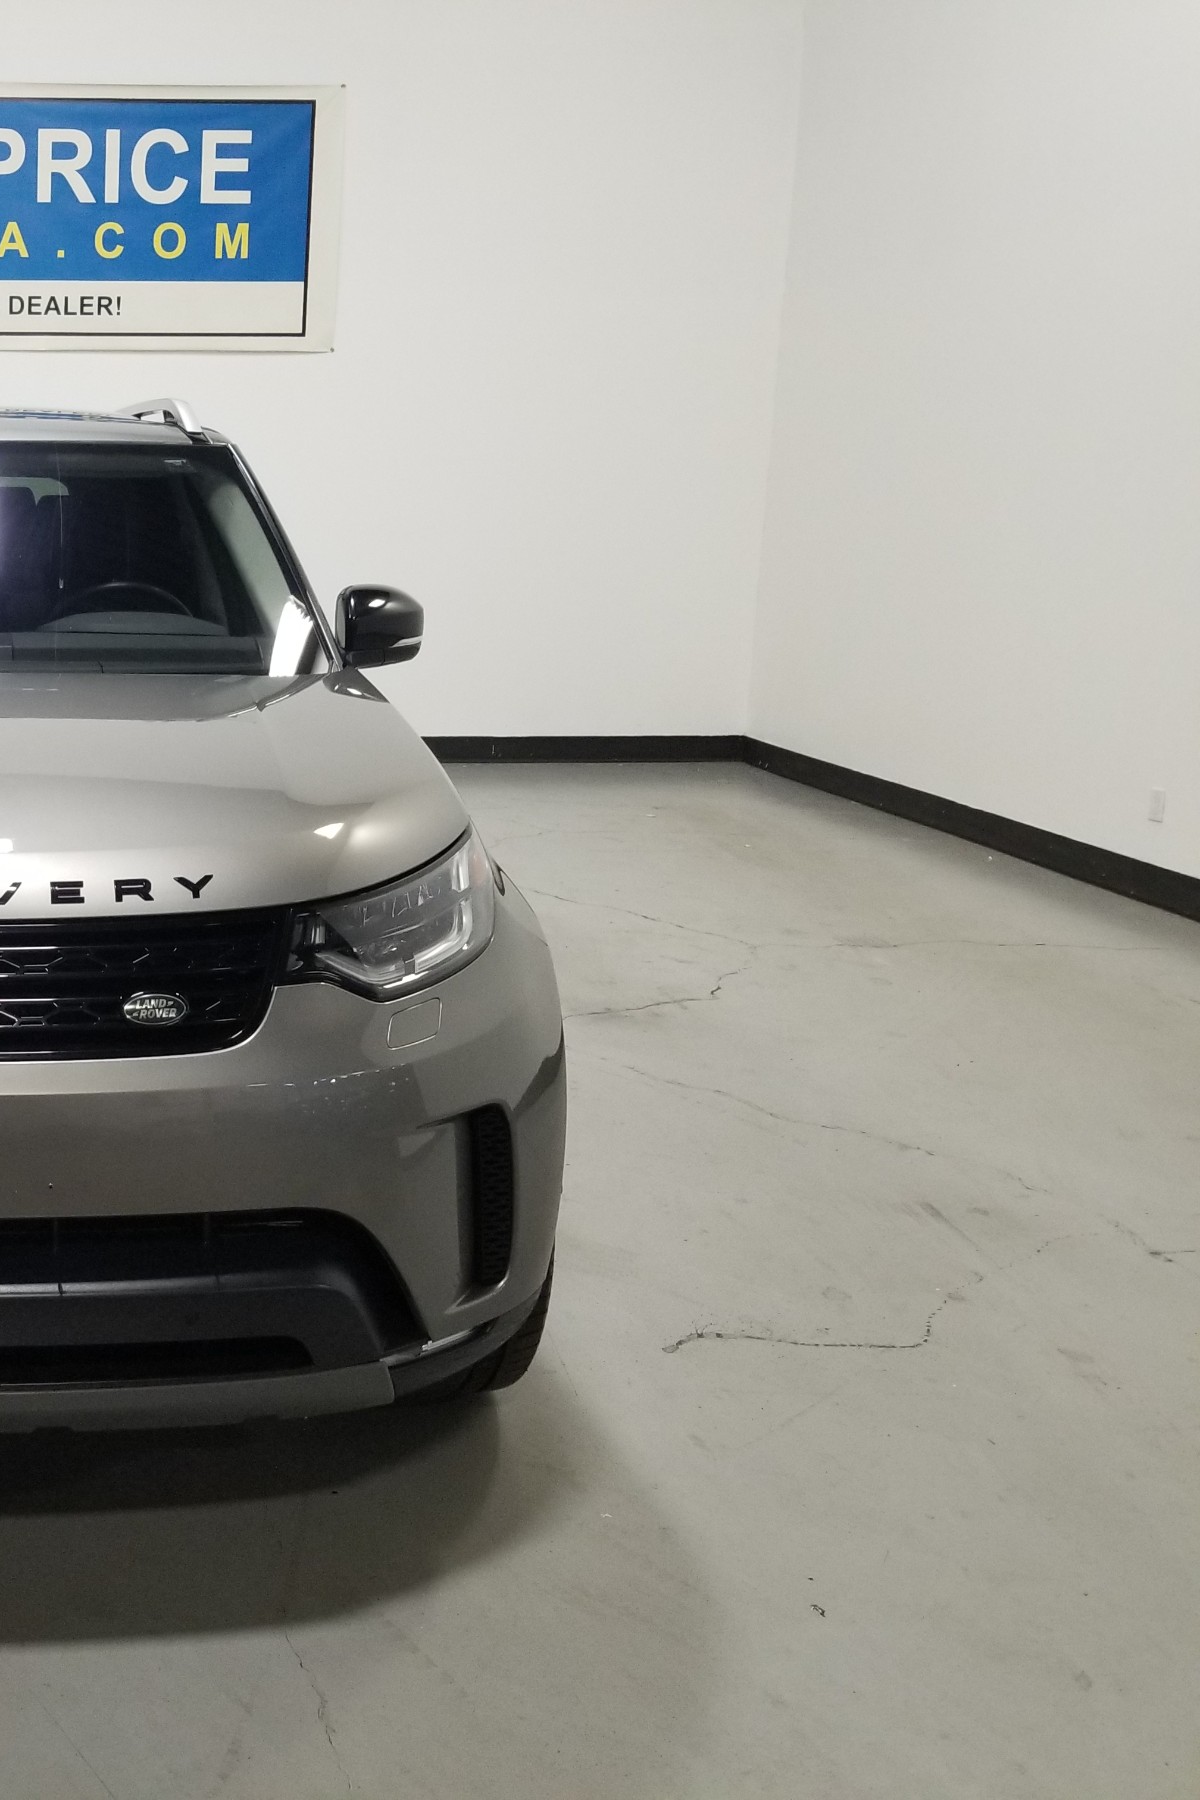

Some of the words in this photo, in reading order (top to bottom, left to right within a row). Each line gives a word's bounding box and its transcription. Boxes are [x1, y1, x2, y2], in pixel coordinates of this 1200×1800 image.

[7, 295, 122, 317] DEALER!
[135, 999, 167, 1009] LAND
[139, 1008, 177, 1019] ROVER
